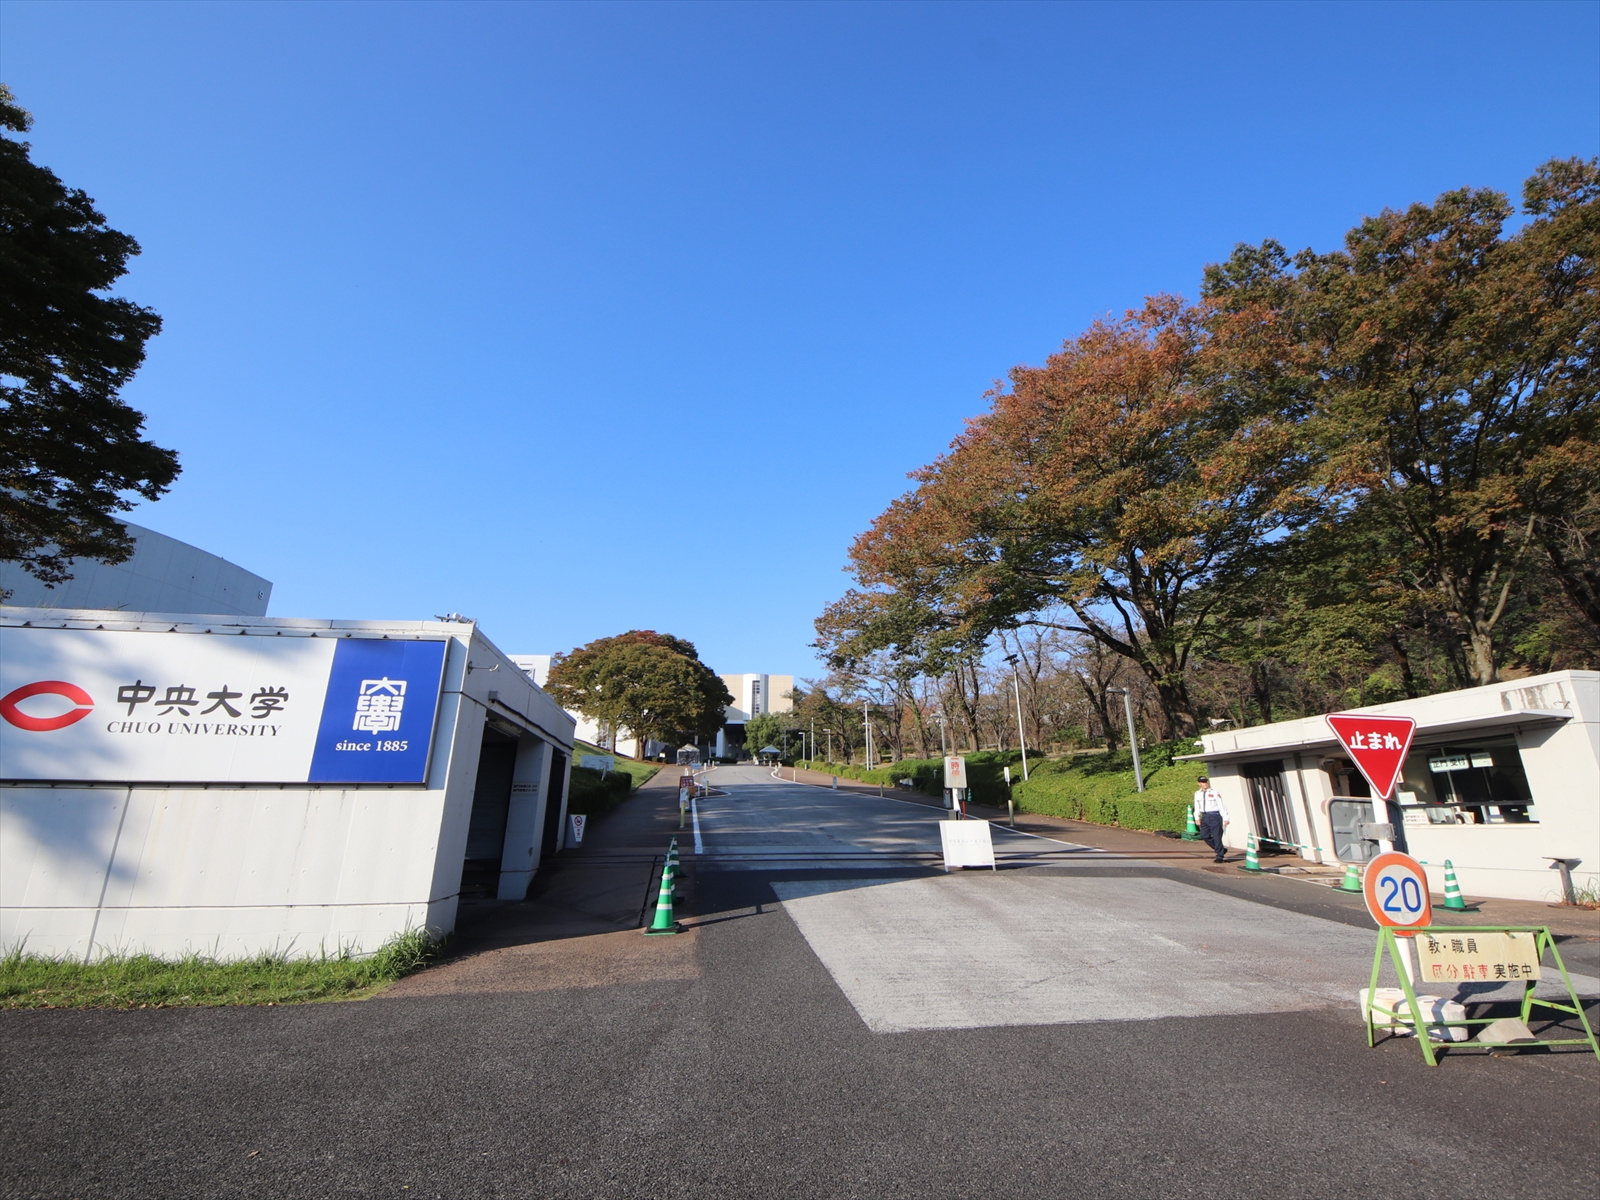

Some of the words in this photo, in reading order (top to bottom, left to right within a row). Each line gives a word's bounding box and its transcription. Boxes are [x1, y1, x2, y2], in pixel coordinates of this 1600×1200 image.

[117, 680, 289, 719] 中央大学
[107, 721, 161, 734] CHUO
[168, 723, 282, 736] UNIVERSITY
[335, 740, 371, 751] since
[375, 740, 408, 752] 1885
[1349, 731, 1402, 750] 止まれ
[1380, 876, 1421, 913] 20
